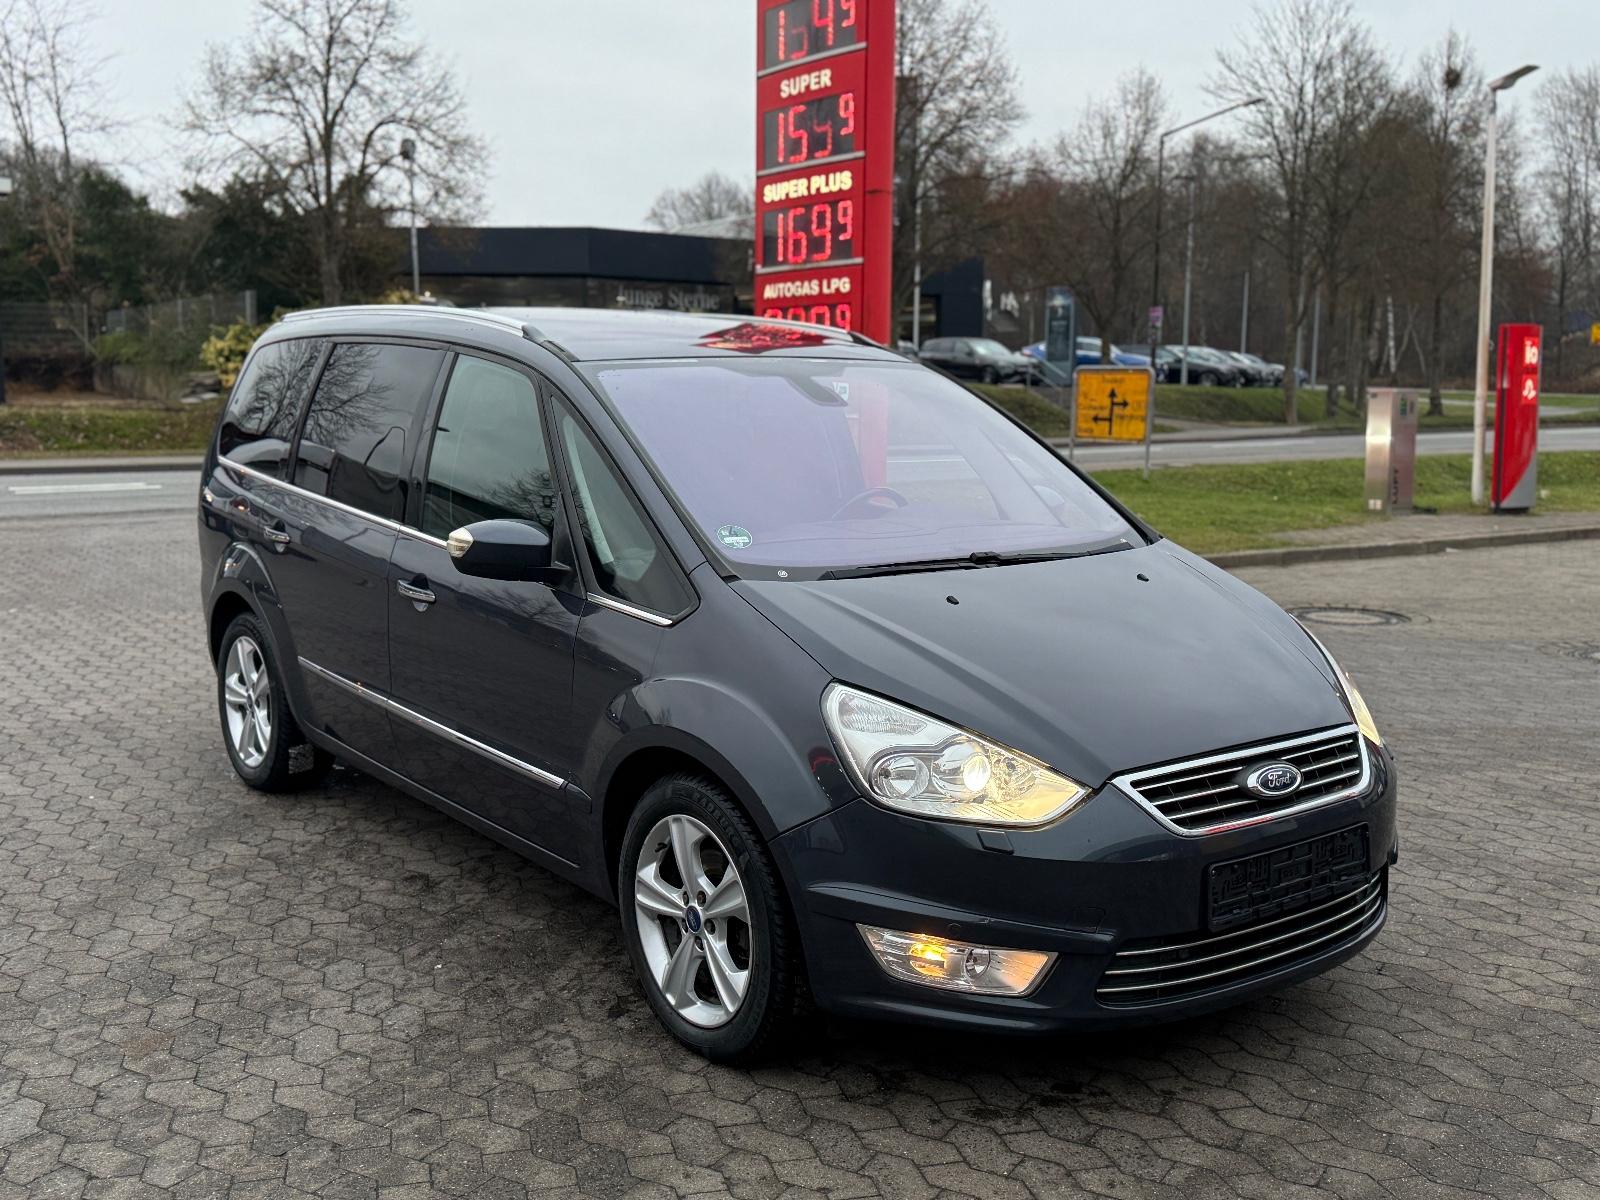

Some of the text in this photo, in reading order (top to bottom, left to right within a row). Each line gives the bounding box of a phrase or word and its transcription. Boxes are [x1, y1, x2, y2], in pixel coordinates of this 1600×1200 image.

[780, 68, 832, 98] SUPER
[763, 170, 853, 203] SUPER PLUS
[777, 200, 853, 264] 1699
[763, 277, 851, 300] AUTOGAS LPG
[1267, 770, 1291, 788] Ford
